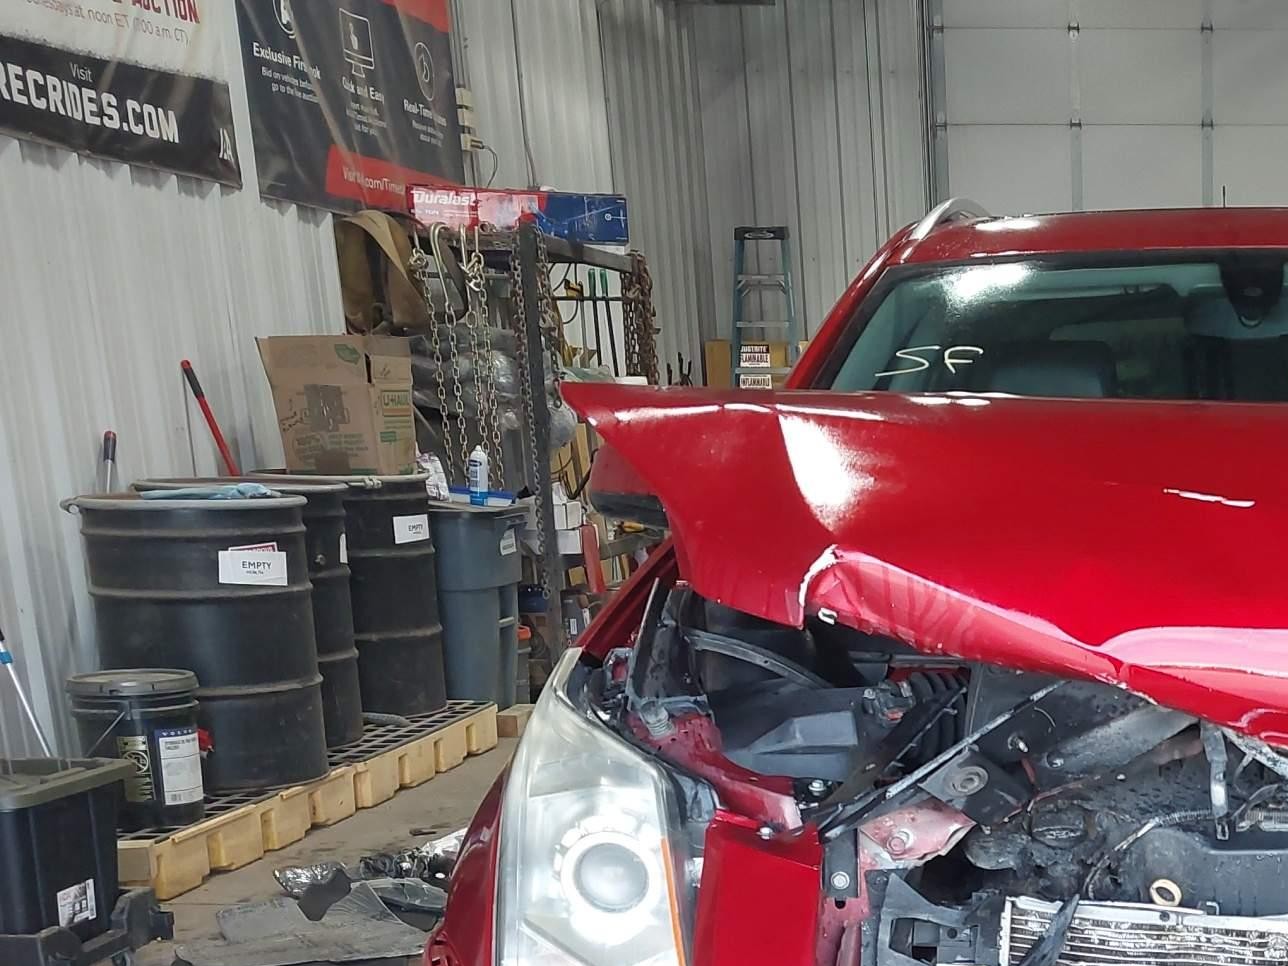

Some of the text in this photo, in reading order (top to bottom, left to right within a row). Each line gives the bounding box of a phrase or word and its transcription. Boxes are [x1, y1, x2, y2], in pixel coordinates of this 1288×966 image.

[87, 9, 113, 25] noon
[114, 12, 129, 29] ET
[130, 0, 200, 24] CTION
[253, 42, 292, 67] Exclusive
[69, 62, 93, 83] Visit
[411, 190, 478, 206] Duralast
[875, 345, 985, 376] SF
[241, 560, 272, 571] EMPTY
